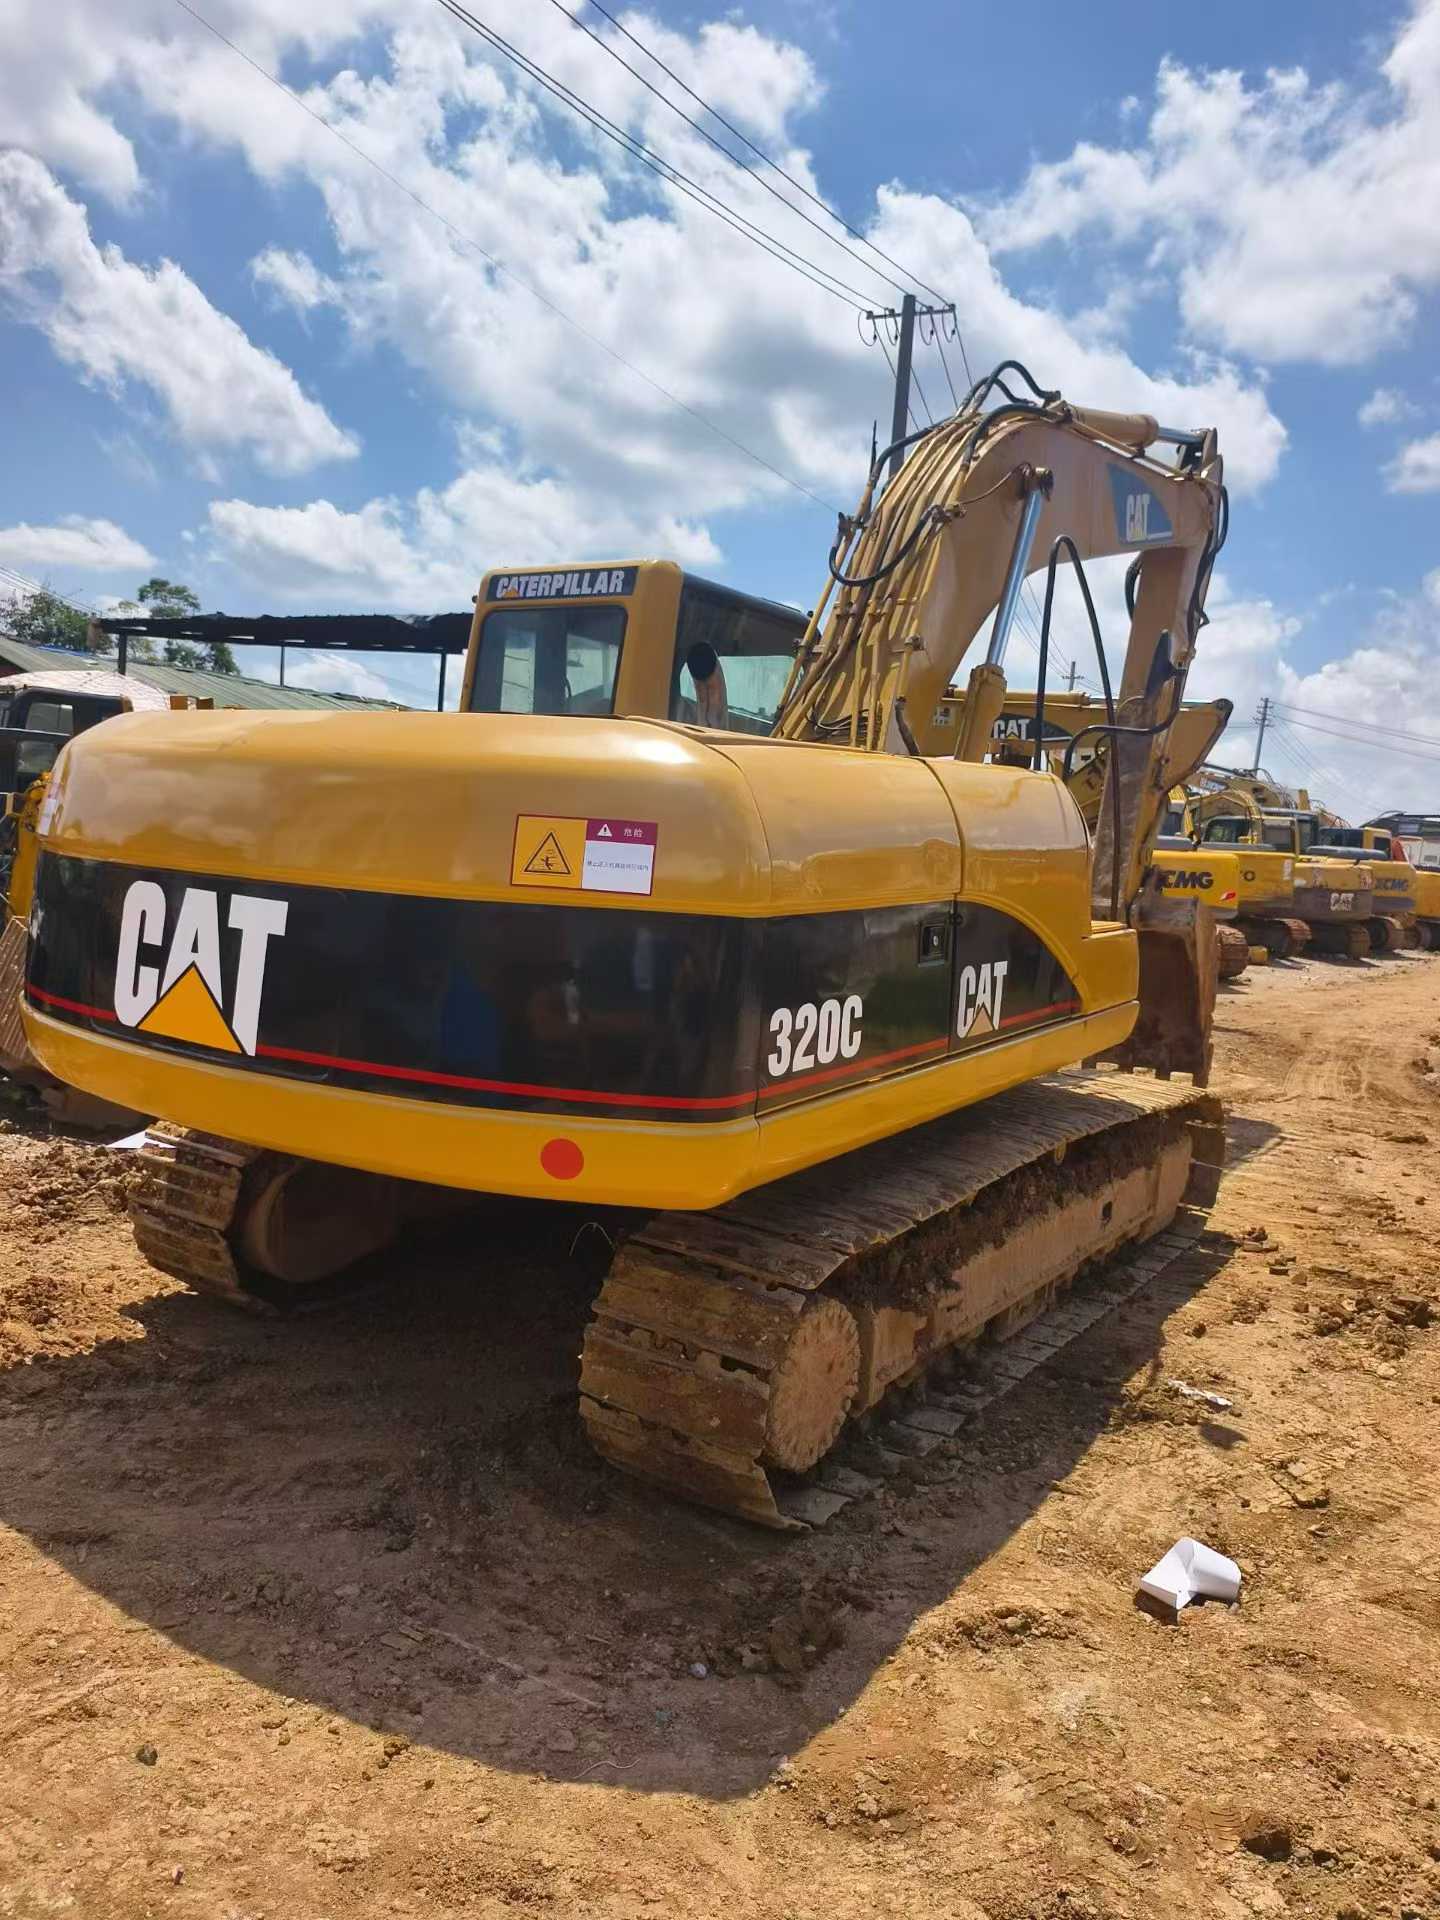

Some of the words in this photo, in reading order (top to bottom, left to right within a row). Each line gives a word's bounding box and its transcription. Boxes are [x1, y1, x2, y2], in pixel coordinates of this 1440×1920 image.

[1126, 493, 1150, 542] CAT
[496, 570, 625, 598] CATERPILLAR
[993, 718, 1031, 740] CAT
[1158, 868, 1214, 889] CMG
[114, 880, 289, 1057] CAT
[956, 960, 1009, 1039] CAT
[767, 994, 863, 1077] 320C
